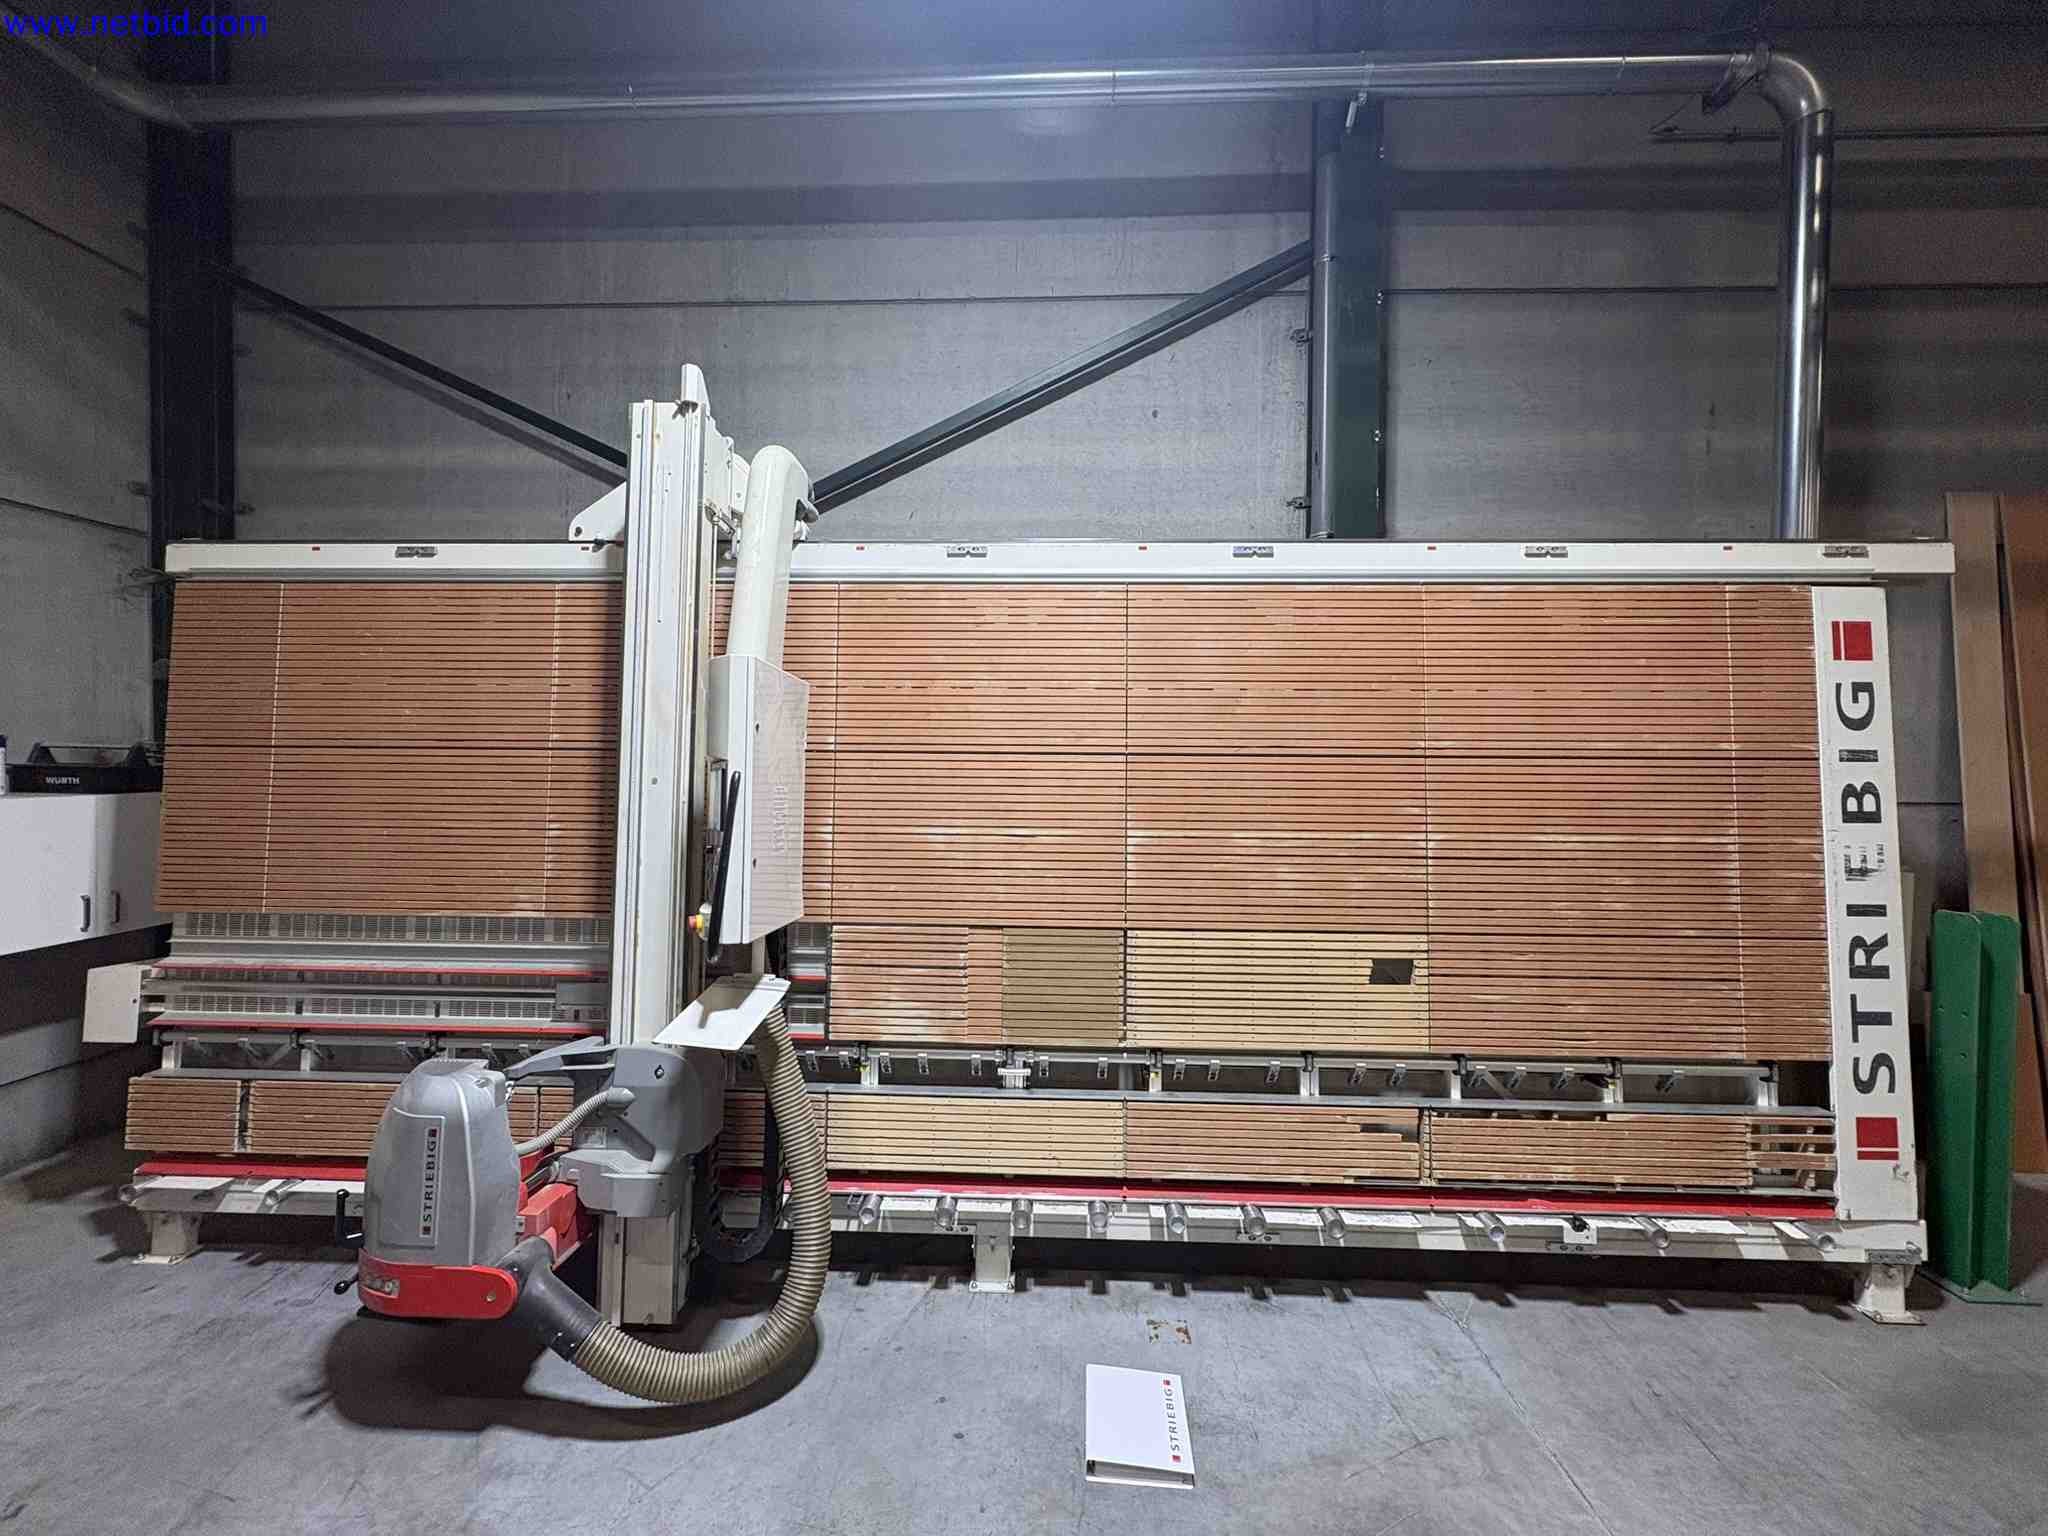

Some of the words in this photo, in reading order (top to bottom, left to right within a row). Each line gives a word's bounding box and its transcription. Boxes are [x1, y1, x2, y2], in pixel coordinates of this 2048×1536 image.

[1835, 682, 1896, 1094] STRIEBIG
[423, 1139, 437, 1222] STRIEBIG
[1164, 1388, 1180, 1451] STRIEBIG
